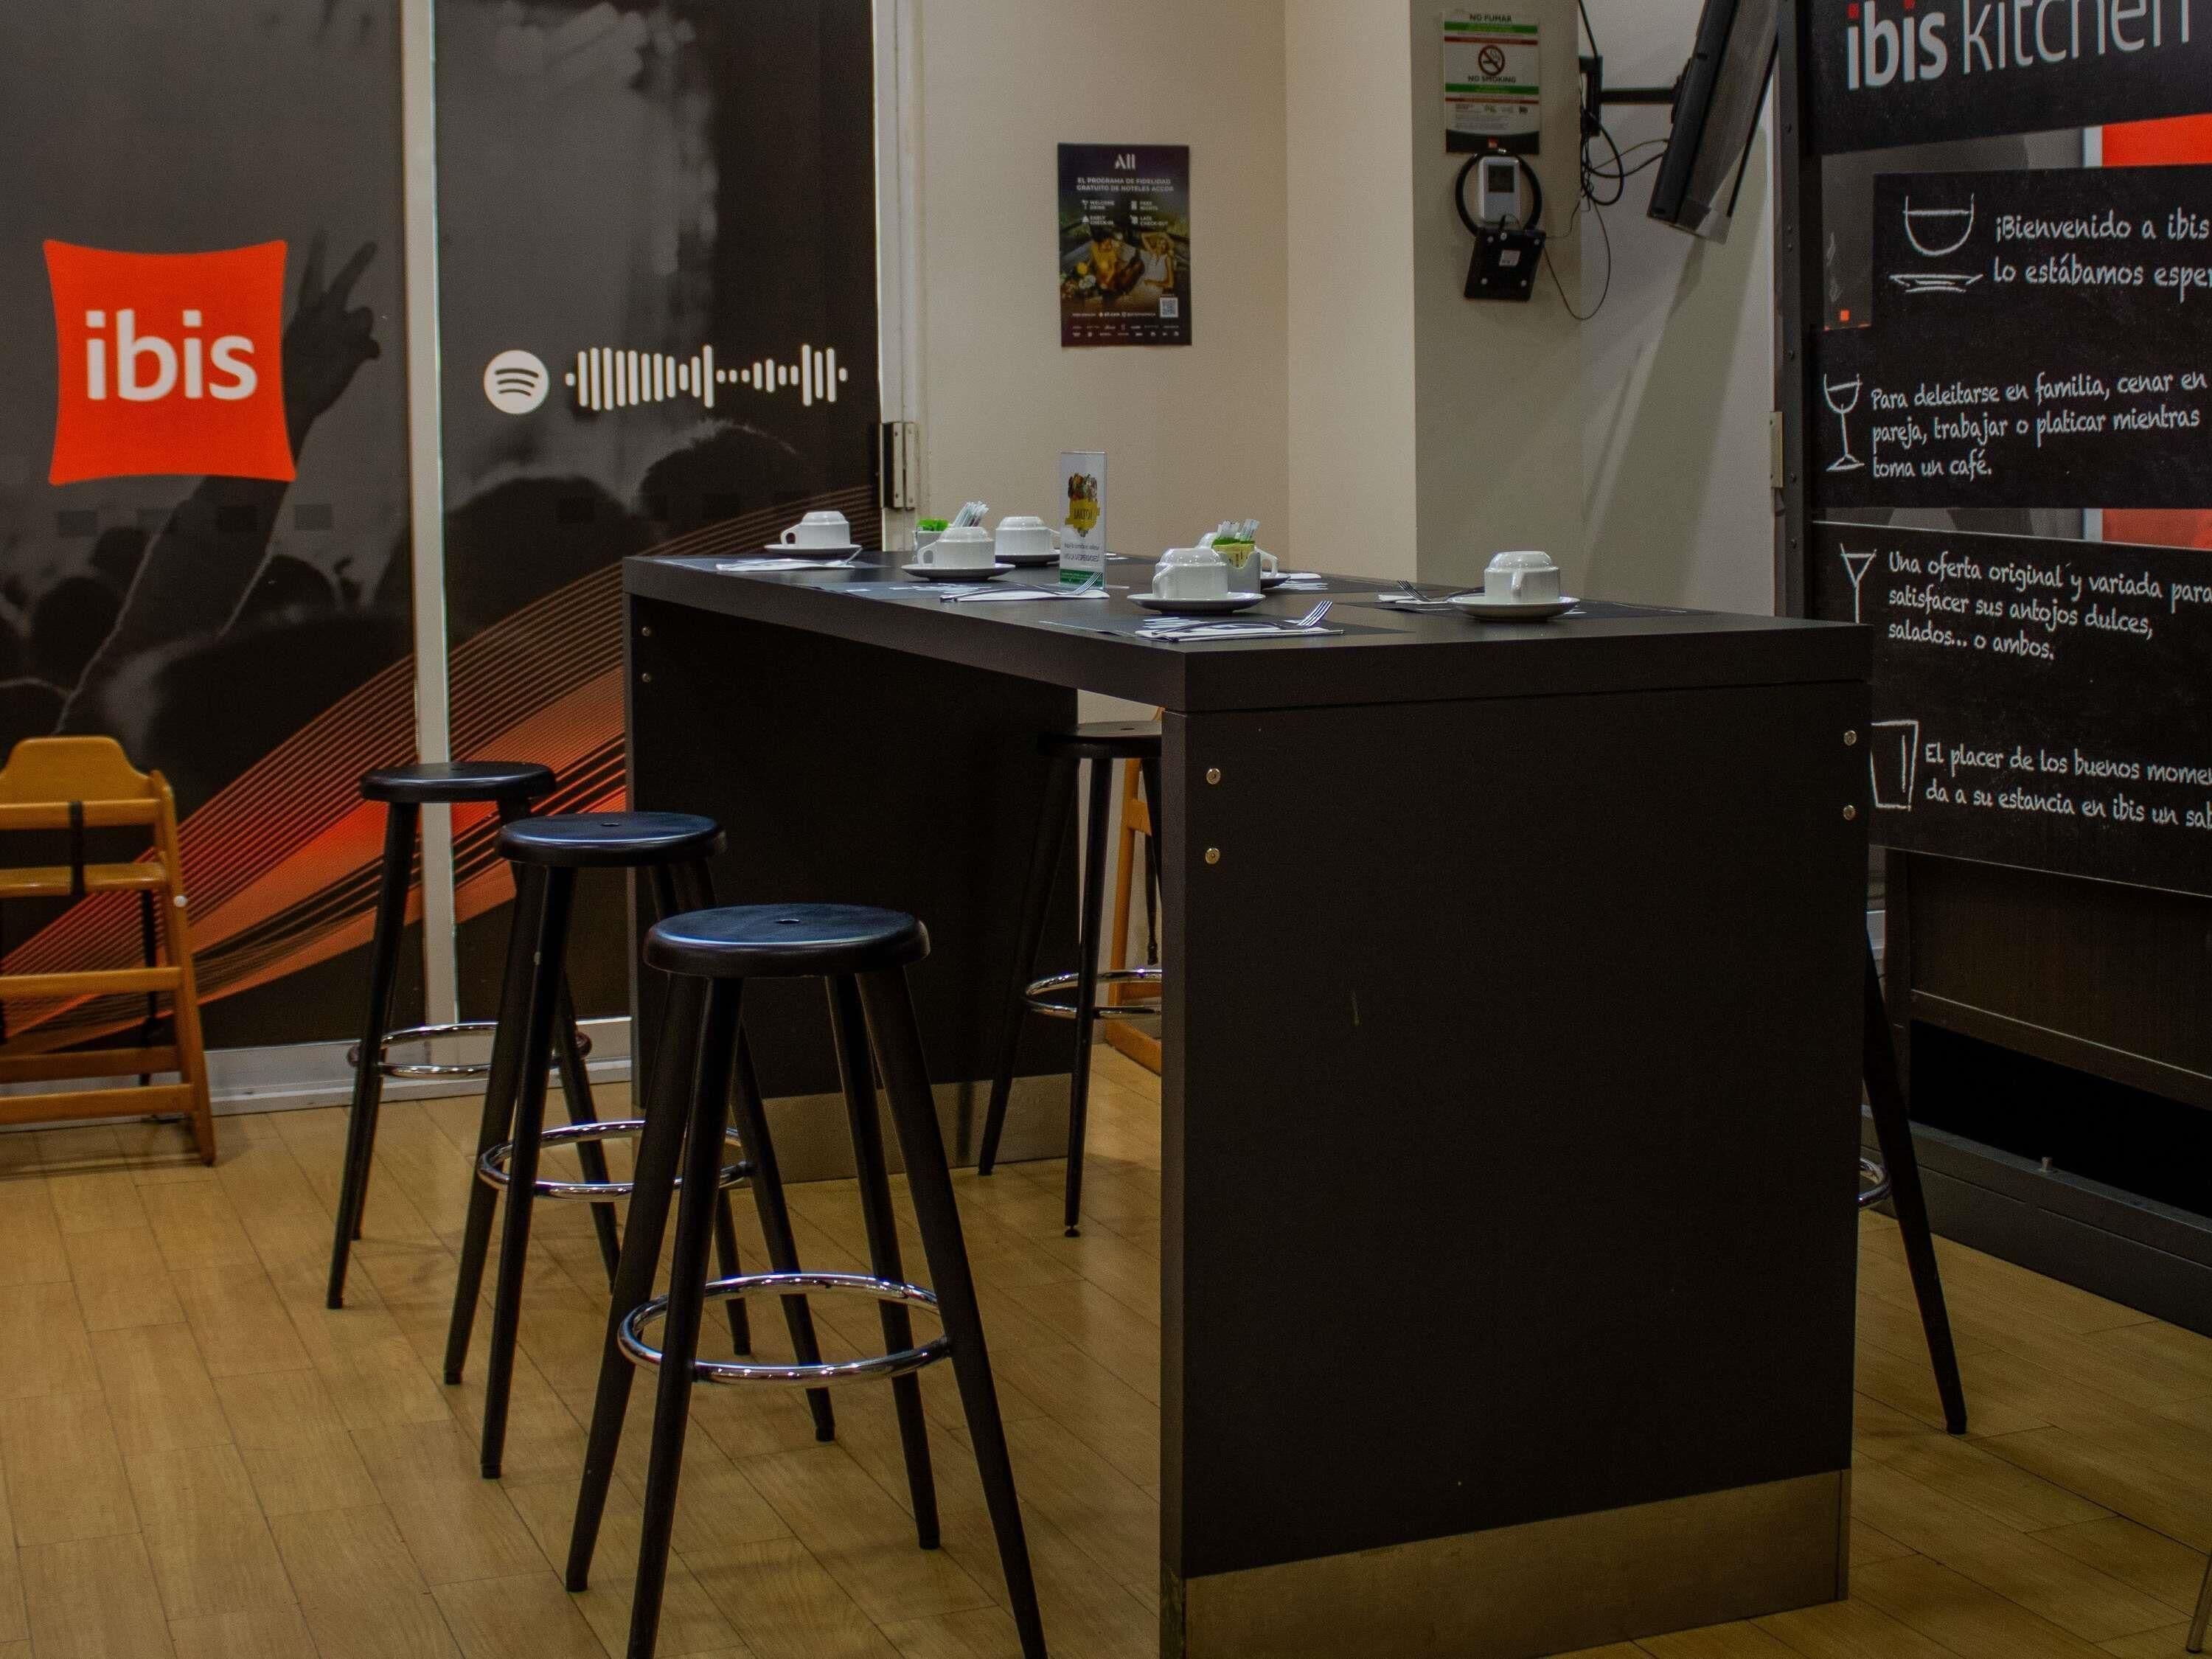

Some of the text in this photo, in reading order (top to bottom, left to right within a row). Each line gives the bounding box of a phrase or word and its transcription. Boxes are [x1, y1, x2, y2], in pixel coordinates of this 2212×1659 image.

[1848, 0, 1948, 90] ibis
[1481, 75, 1516, 83] SMOKING
[1995, 206, 2211, 243] ¡Bienvenido a ibis
[1993, 256, 2017, 283] lo
[2025, 252, 2144, 286] estábamos
[86, 309, 259, 402] ibis
[1871, 372, 2209, 410] Para deleitarse en familia, cenar en
[1871, 404, 2202, 453] pareja, trabajar o platicar mientras
[1873, 448, 1993, 481] toma un café.
[1888, 551, 1920, 574] Una
[1927, 551, 1982, 582] oferta
[1989, 563, 2064, 591] original
[2089, 571, 2163, 599] variada
[2171, 583, 2212, 614] para
[1888, 584, 2153, 641] satisfacer sus antojos dulces,
[1888, 620, 2055, 661] salados... o ambos.
[1924, 742, 1944, 763] El
[1950, 743, 2004, 778] placer
[2009, 746, 2034, 771] de
[2040, 748, 2067, 773] los
[2074, 748, 2140, 779] buenos
[1925, 778, 1950, 803] da
[1955, 787, 1966, 804] a
[1972, 792, 1993, 807] su
[1998, 787, 2076, 815] estancia
[2081, 800, 2107, 818] en
[2112, 792, 2145, 821] ibis
[2152, 806, 2180, 825] un
